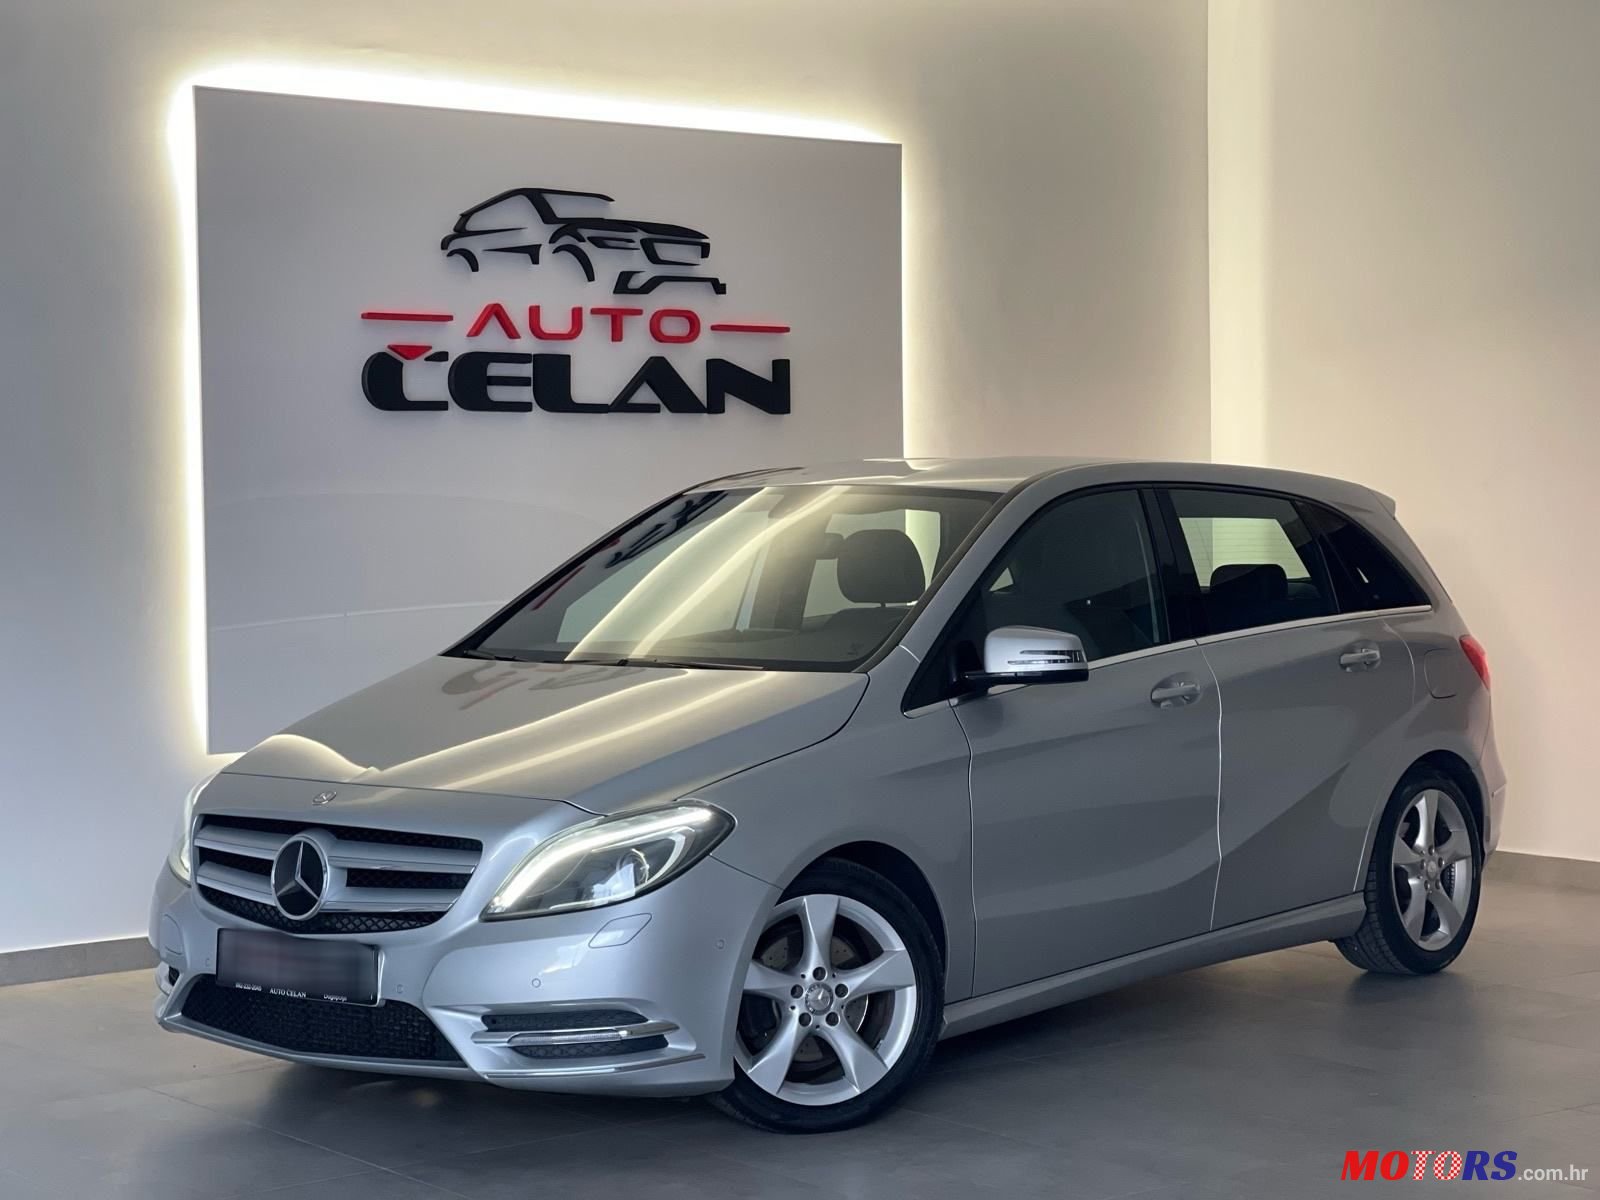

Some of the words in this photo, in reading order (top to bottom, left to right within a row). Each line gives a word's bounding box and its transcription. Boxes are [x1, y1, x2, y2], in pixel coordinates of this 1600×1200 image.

[466, 303, 701, 343] AUTO
[361, 344, 791, 414] ČELAN
[269, 987, 286, 996] AUTO
